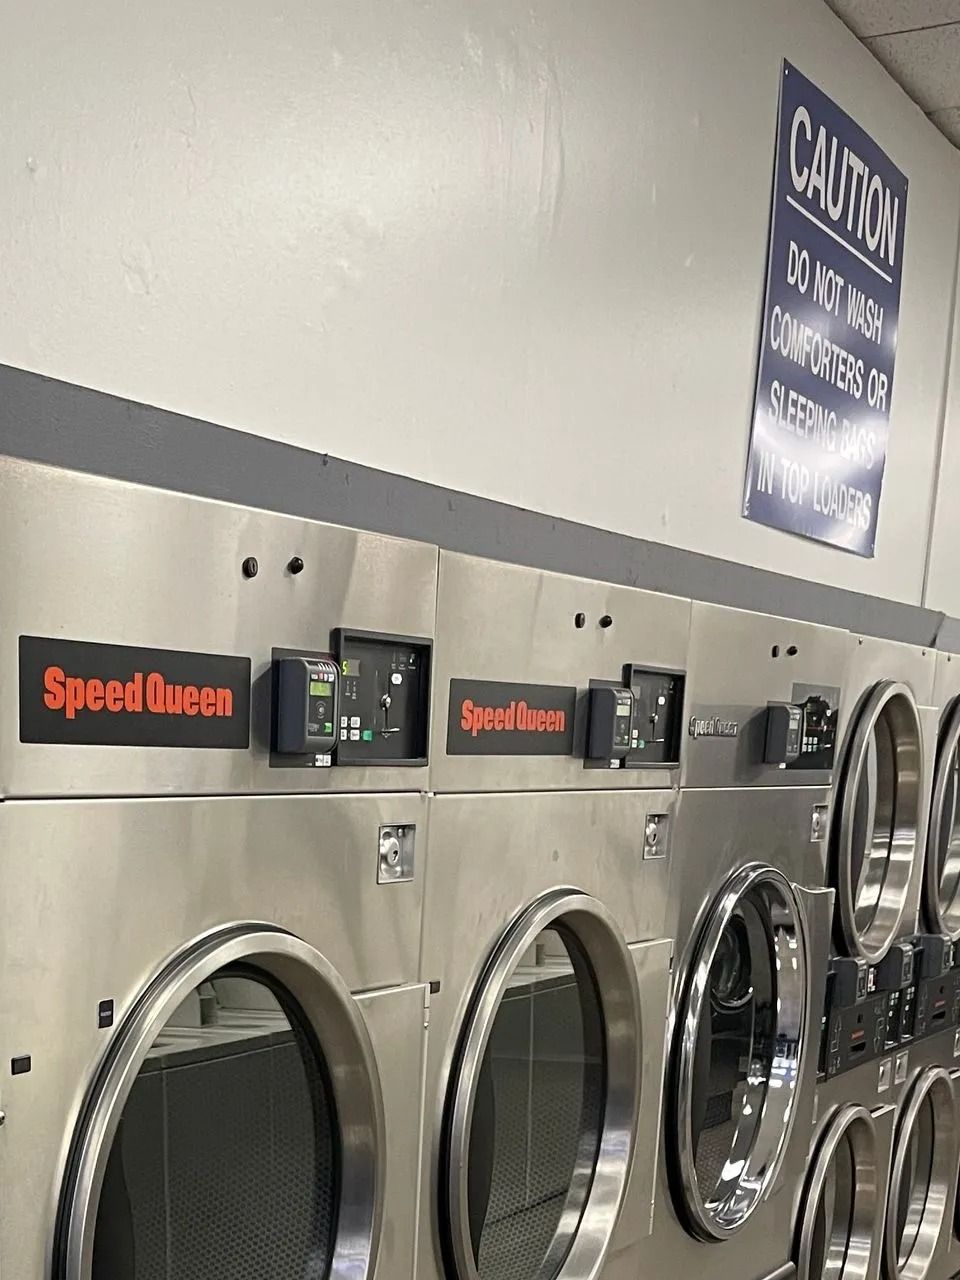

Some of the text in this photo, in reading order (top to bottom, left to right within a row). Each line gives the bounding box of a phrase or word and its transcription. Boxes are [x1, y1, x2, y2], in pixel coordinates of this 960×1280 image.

[791, 106, 899, 266] CAUTION
[787, 241, 883, 345] DO NOT WASH
[770, 305, 888, 412] COMFORTERS OR
[768, 380, 877, 470] SLEEPING BAGS
[757, 450, 872, 532] IN TOP LOADERS
[43, 666, 233, 720] Speed Queen
[460, 699, 565, 737] Speed Queen
